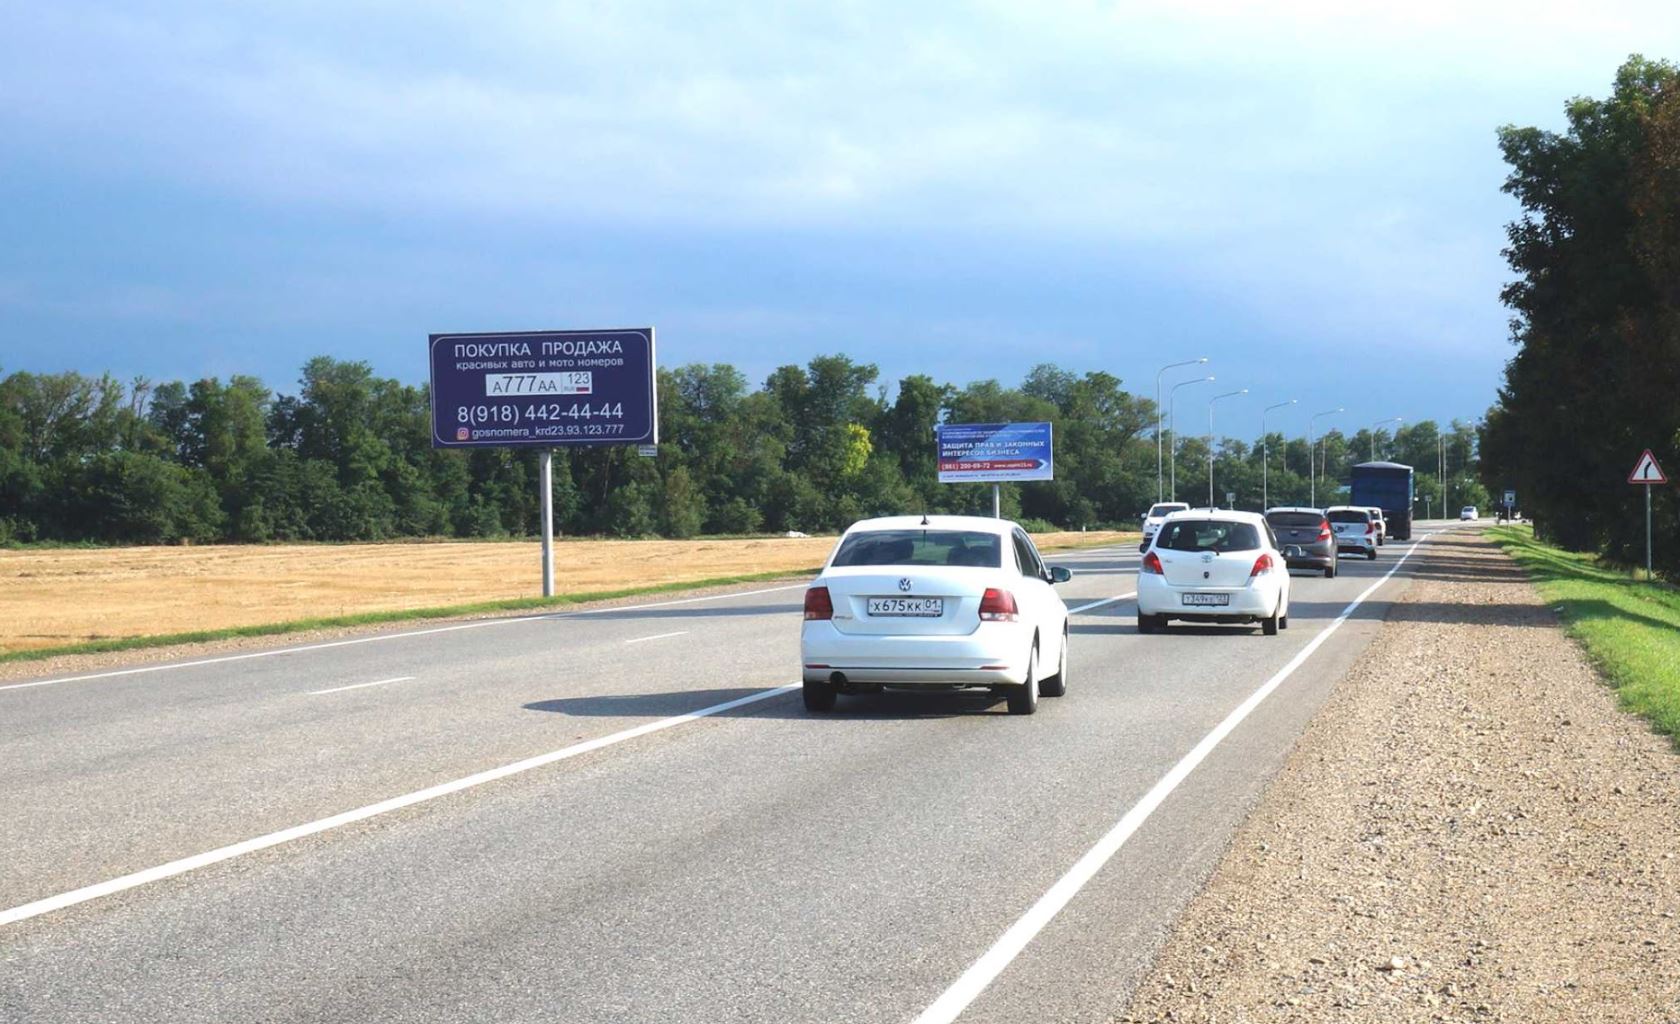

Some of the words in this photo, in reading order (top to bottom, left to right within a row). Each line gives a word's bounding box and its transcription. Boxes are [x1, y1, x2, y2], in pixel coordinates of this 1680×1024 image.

[454, 342, 532, 358] ПОКУПКА
[542, 340, 623, 357] ПРОДАЖА
[456, 360, 508, 371] красивых
[511, 360, 535, 369] авто
[538, 359, 546, 368] и
[549, 358, 574, 367] мото
[577, 357, 624, 368] номеров
[567, 372, 590, 384] 123
[457, 404, 520, 425] 8(918)
[525, 403, 624, 421] 442-44-44
